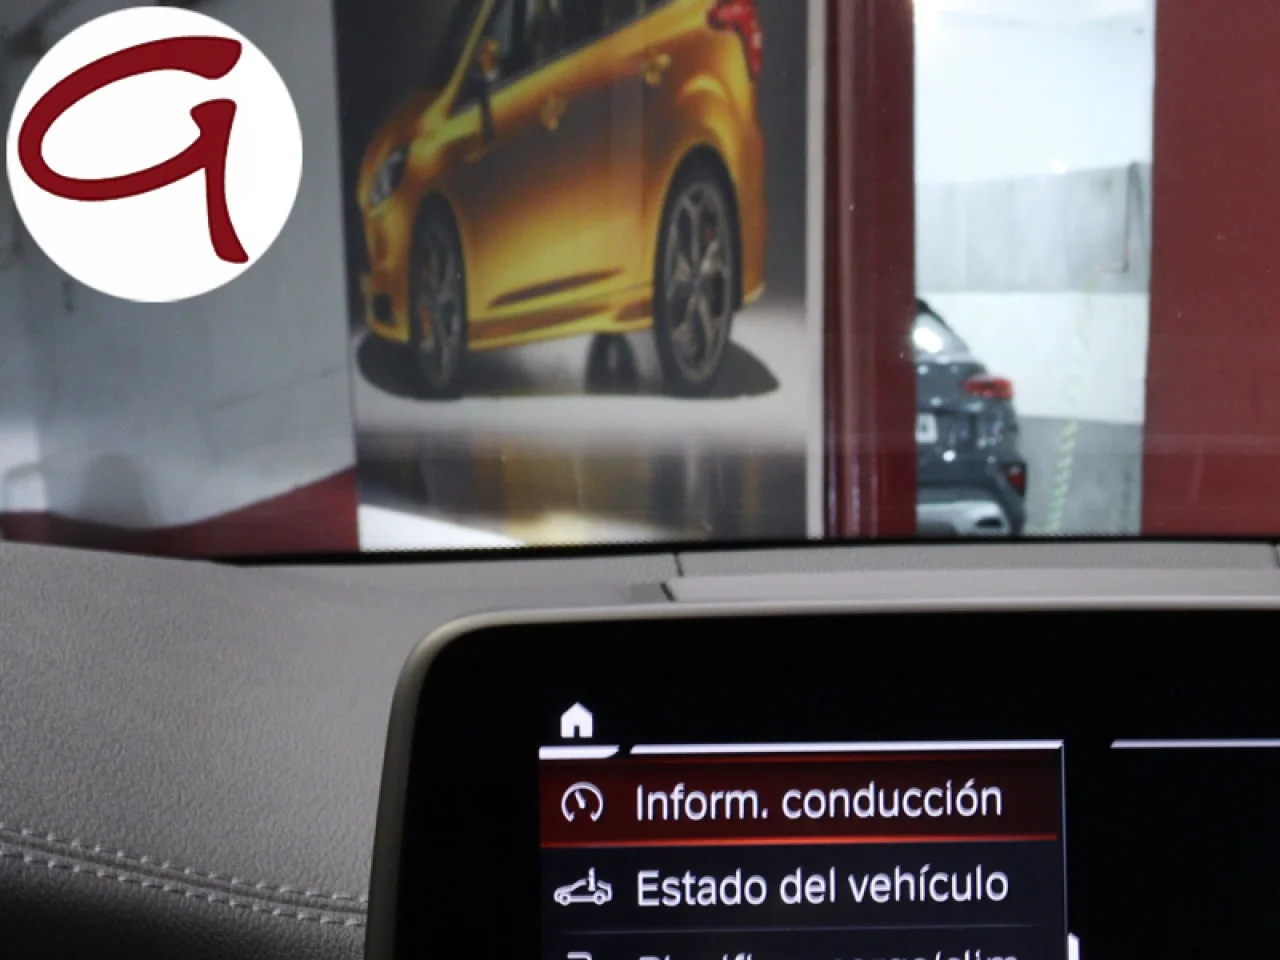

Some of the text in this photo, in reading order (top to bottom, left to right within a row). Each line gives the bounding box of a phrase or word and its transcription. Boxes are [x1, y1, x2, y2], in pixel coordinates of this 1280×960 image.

[636, 778, 1003, 822] Inform. conducción
[637, 863, 1009, 907] Estado del vehículo
